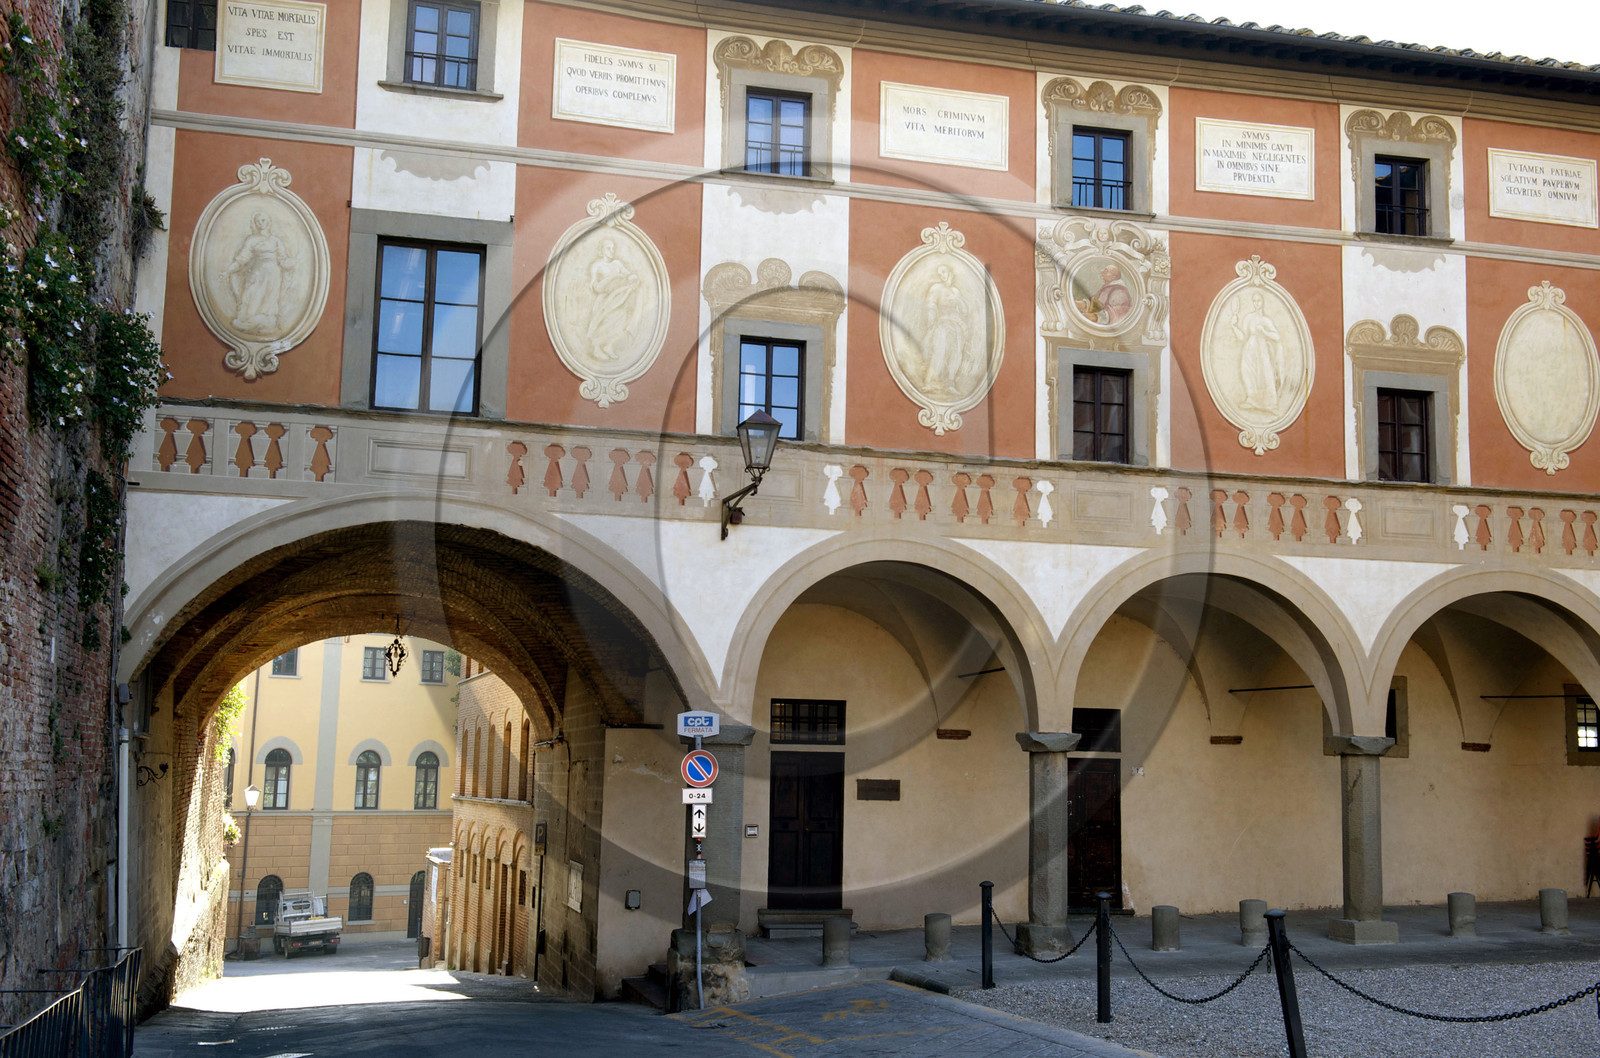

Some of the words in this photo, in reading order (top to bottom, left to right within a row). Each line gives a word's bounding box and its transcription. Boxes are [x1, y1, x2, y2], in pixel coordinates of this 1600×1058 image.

[228, 6, 248, 17] VITA
[252, 9, 275, 21] VITAE
[278, 12, 316, 25] MORTALIS
[245, 28, 267, 38] SPES
[277, 31, 294, 41] EST
[227, 44, 256, 55] VITAE
[262, 48, 312, 62] IMMORTALIS
[584, 53, 613, 66] FIDELES
[618, 59, 643, 70] SVMVS
[649, 63, 656, 72] SI
[566, 67, 586, 78] QVOD
[589, 70, 613, 80] VERBIS
[616, 73, 666, 88] PROMITTIMVS
[575, 85, 609, 97] OPERIBVS
[612, 91, 657, 103] COMPLEMVS
[903, 106, 927, 116] MORS
[937, 109, 985, 123] CRIMINVM
[905, 121, 925, 132] VITA
[934, 125, 985, 139] MERITORVM
[1242, 131, 1270, 140] SVMVS
[1236, 141, 1267, 150] MINIMIS
[1271, 143, 1293, 153] CAVTI
[1203, 149, 1210, 157] IN
[1212, 150, 1246, 159] MAXIMIS
[1252, 152, 1306, 164] NEGLIGENTES
[1217, 160, 1225, 169] IN
[1227, 161, 1258, 172] OMNIBVS
[1261, 164, 1280, 173] SINE
[1508, 163, 1545, 175] TVTAMEN
[1551, 168, 1582, 179] PATRIAE
[1233, 172, 1276, 184] PRVDENTIA
[1501, 175, 1537, 185] SOLATIVM
[1543, 178, 1580, 190] PAVPERVM
[1505, 186, 1542, 197] SECVRITAS
[1547, 191, 1578, 201] OMNIVM
[687, 716, 710, 726] cpt
[537, 825, 544, 842] P
